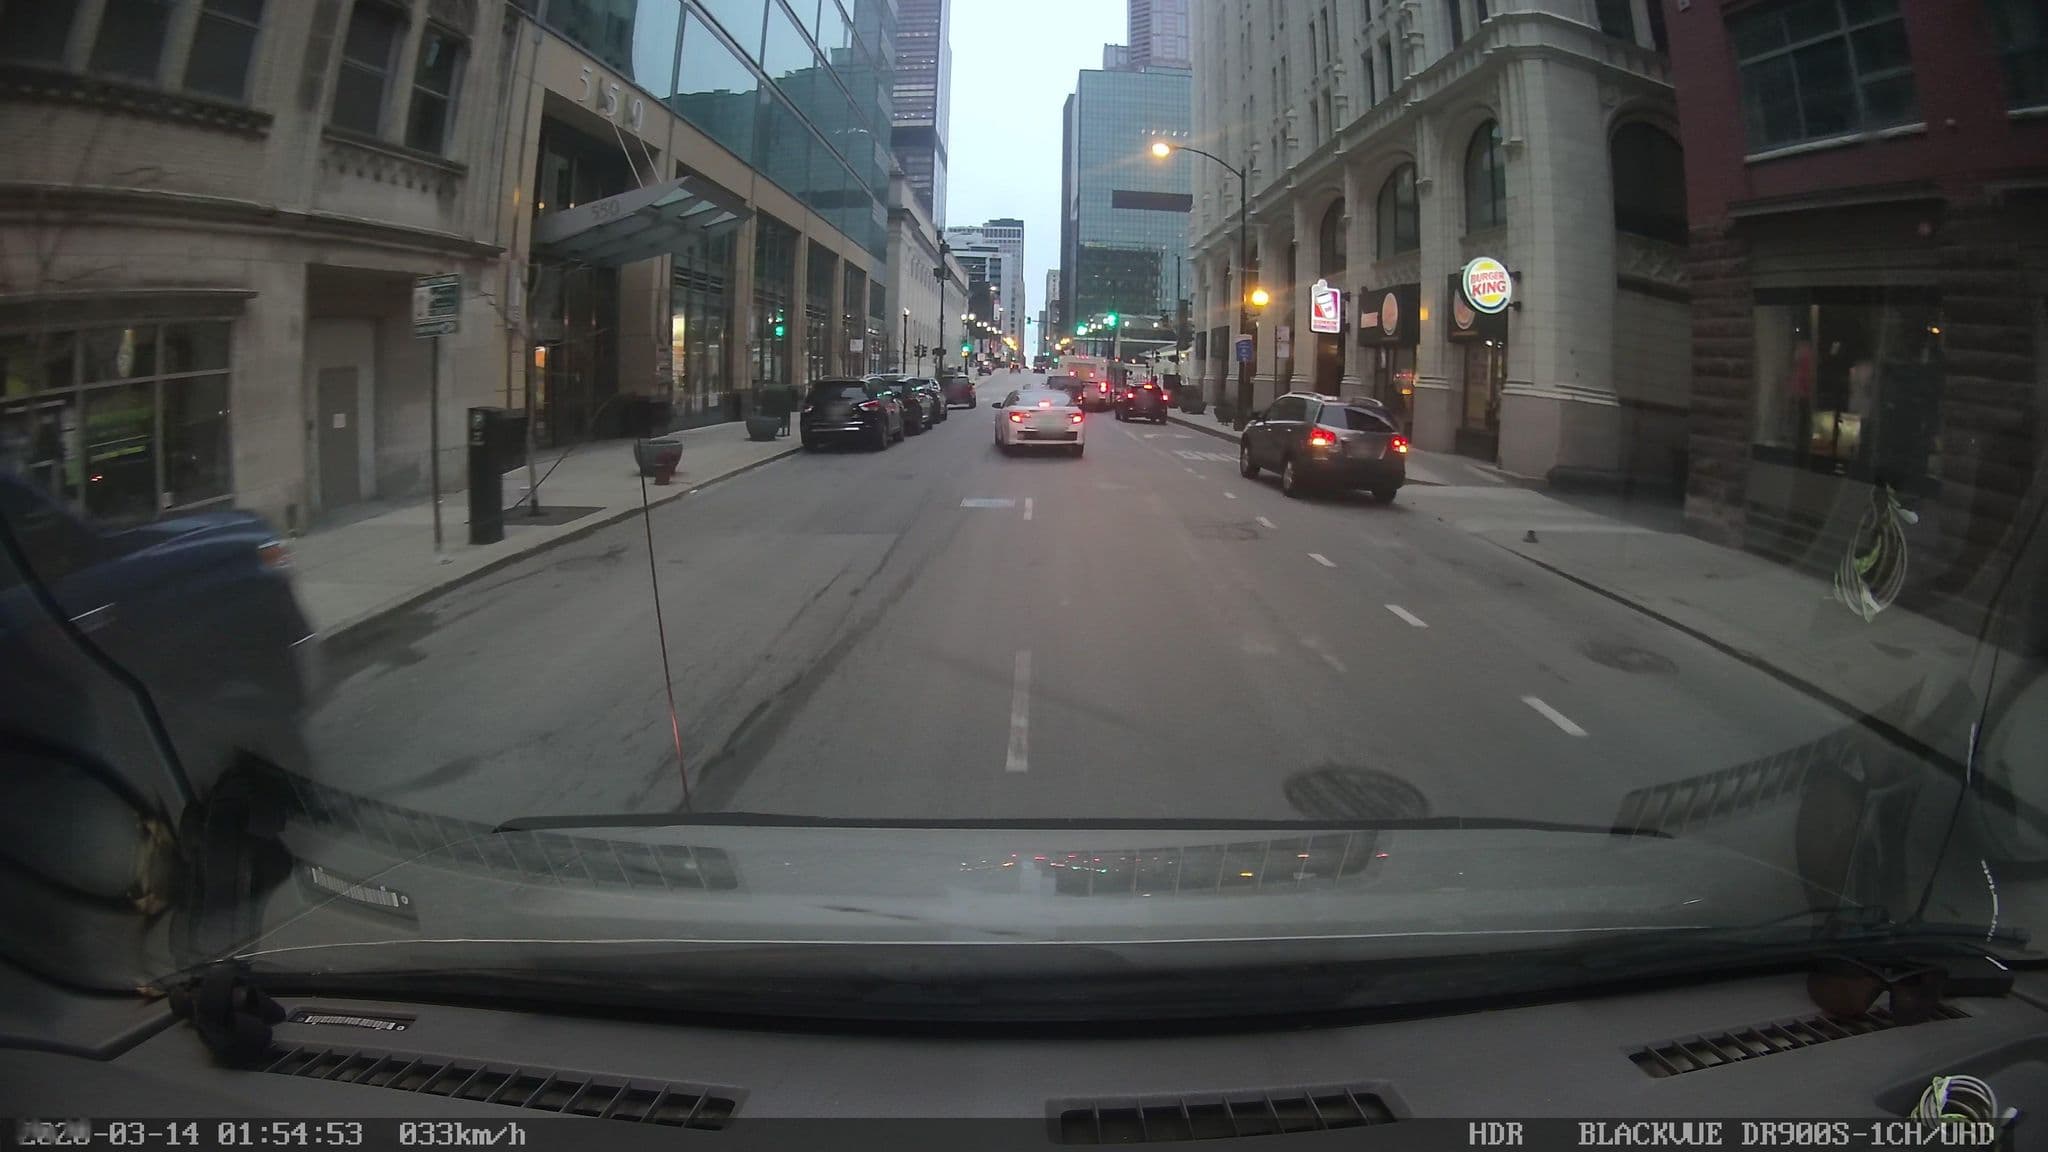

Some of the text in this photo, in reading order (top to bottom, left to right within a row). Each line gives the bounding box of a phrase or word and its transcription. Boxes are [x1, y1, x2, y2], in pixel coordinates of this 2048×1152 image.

[577, 64, 644, 132] 550
[591, 199, 619, 219] 550
[1471, 271, 1505, 284] BURGER
[1472, 280, 1507, 297] KING
